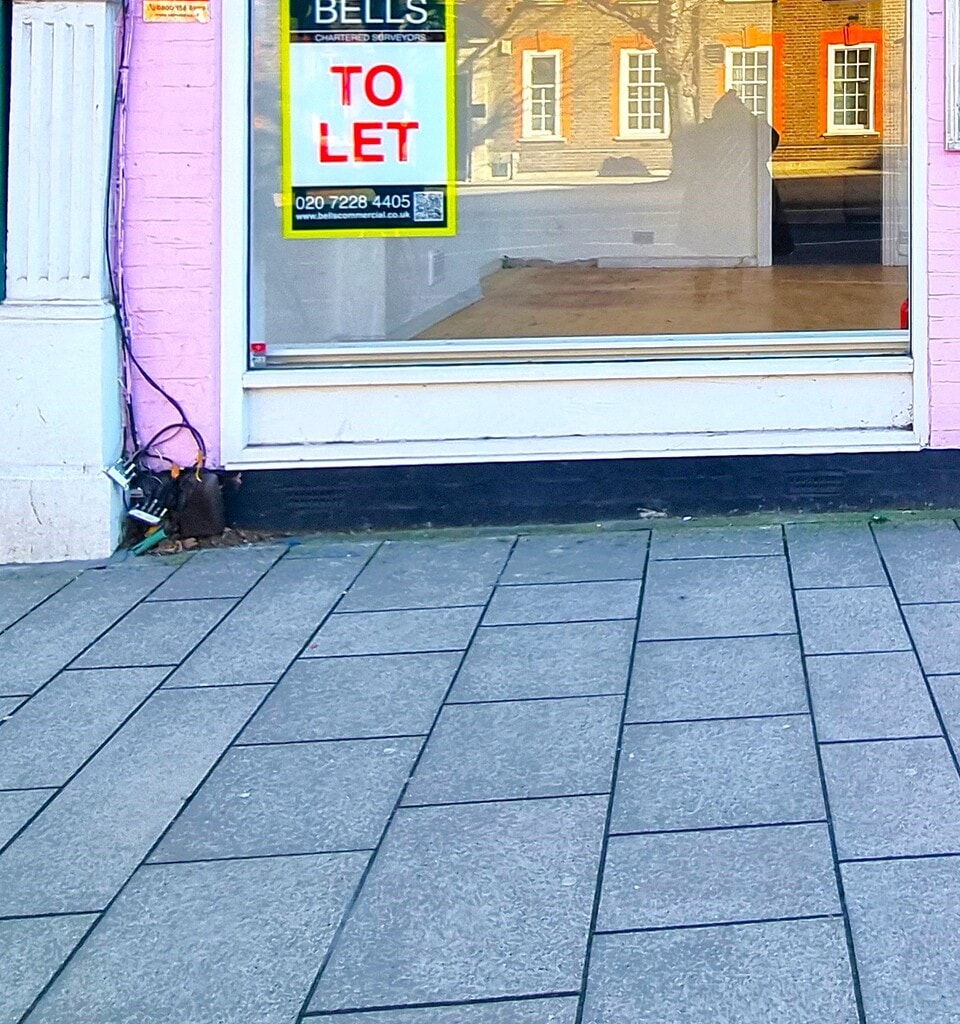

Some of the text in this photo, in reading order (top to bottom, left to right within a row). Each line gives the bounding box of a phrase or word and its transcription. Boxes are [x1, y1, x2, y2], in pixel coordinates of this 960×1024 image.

[315, 33, 427, 42] CHARTERED SURVEYORS
[329, 63, 403, 108] TO
[319, 122, 420, 164] LET
[295, 194, 411, 210] 020 7228 4405
[295, 211, 411, 220] www.bellscommercial.co.uk
